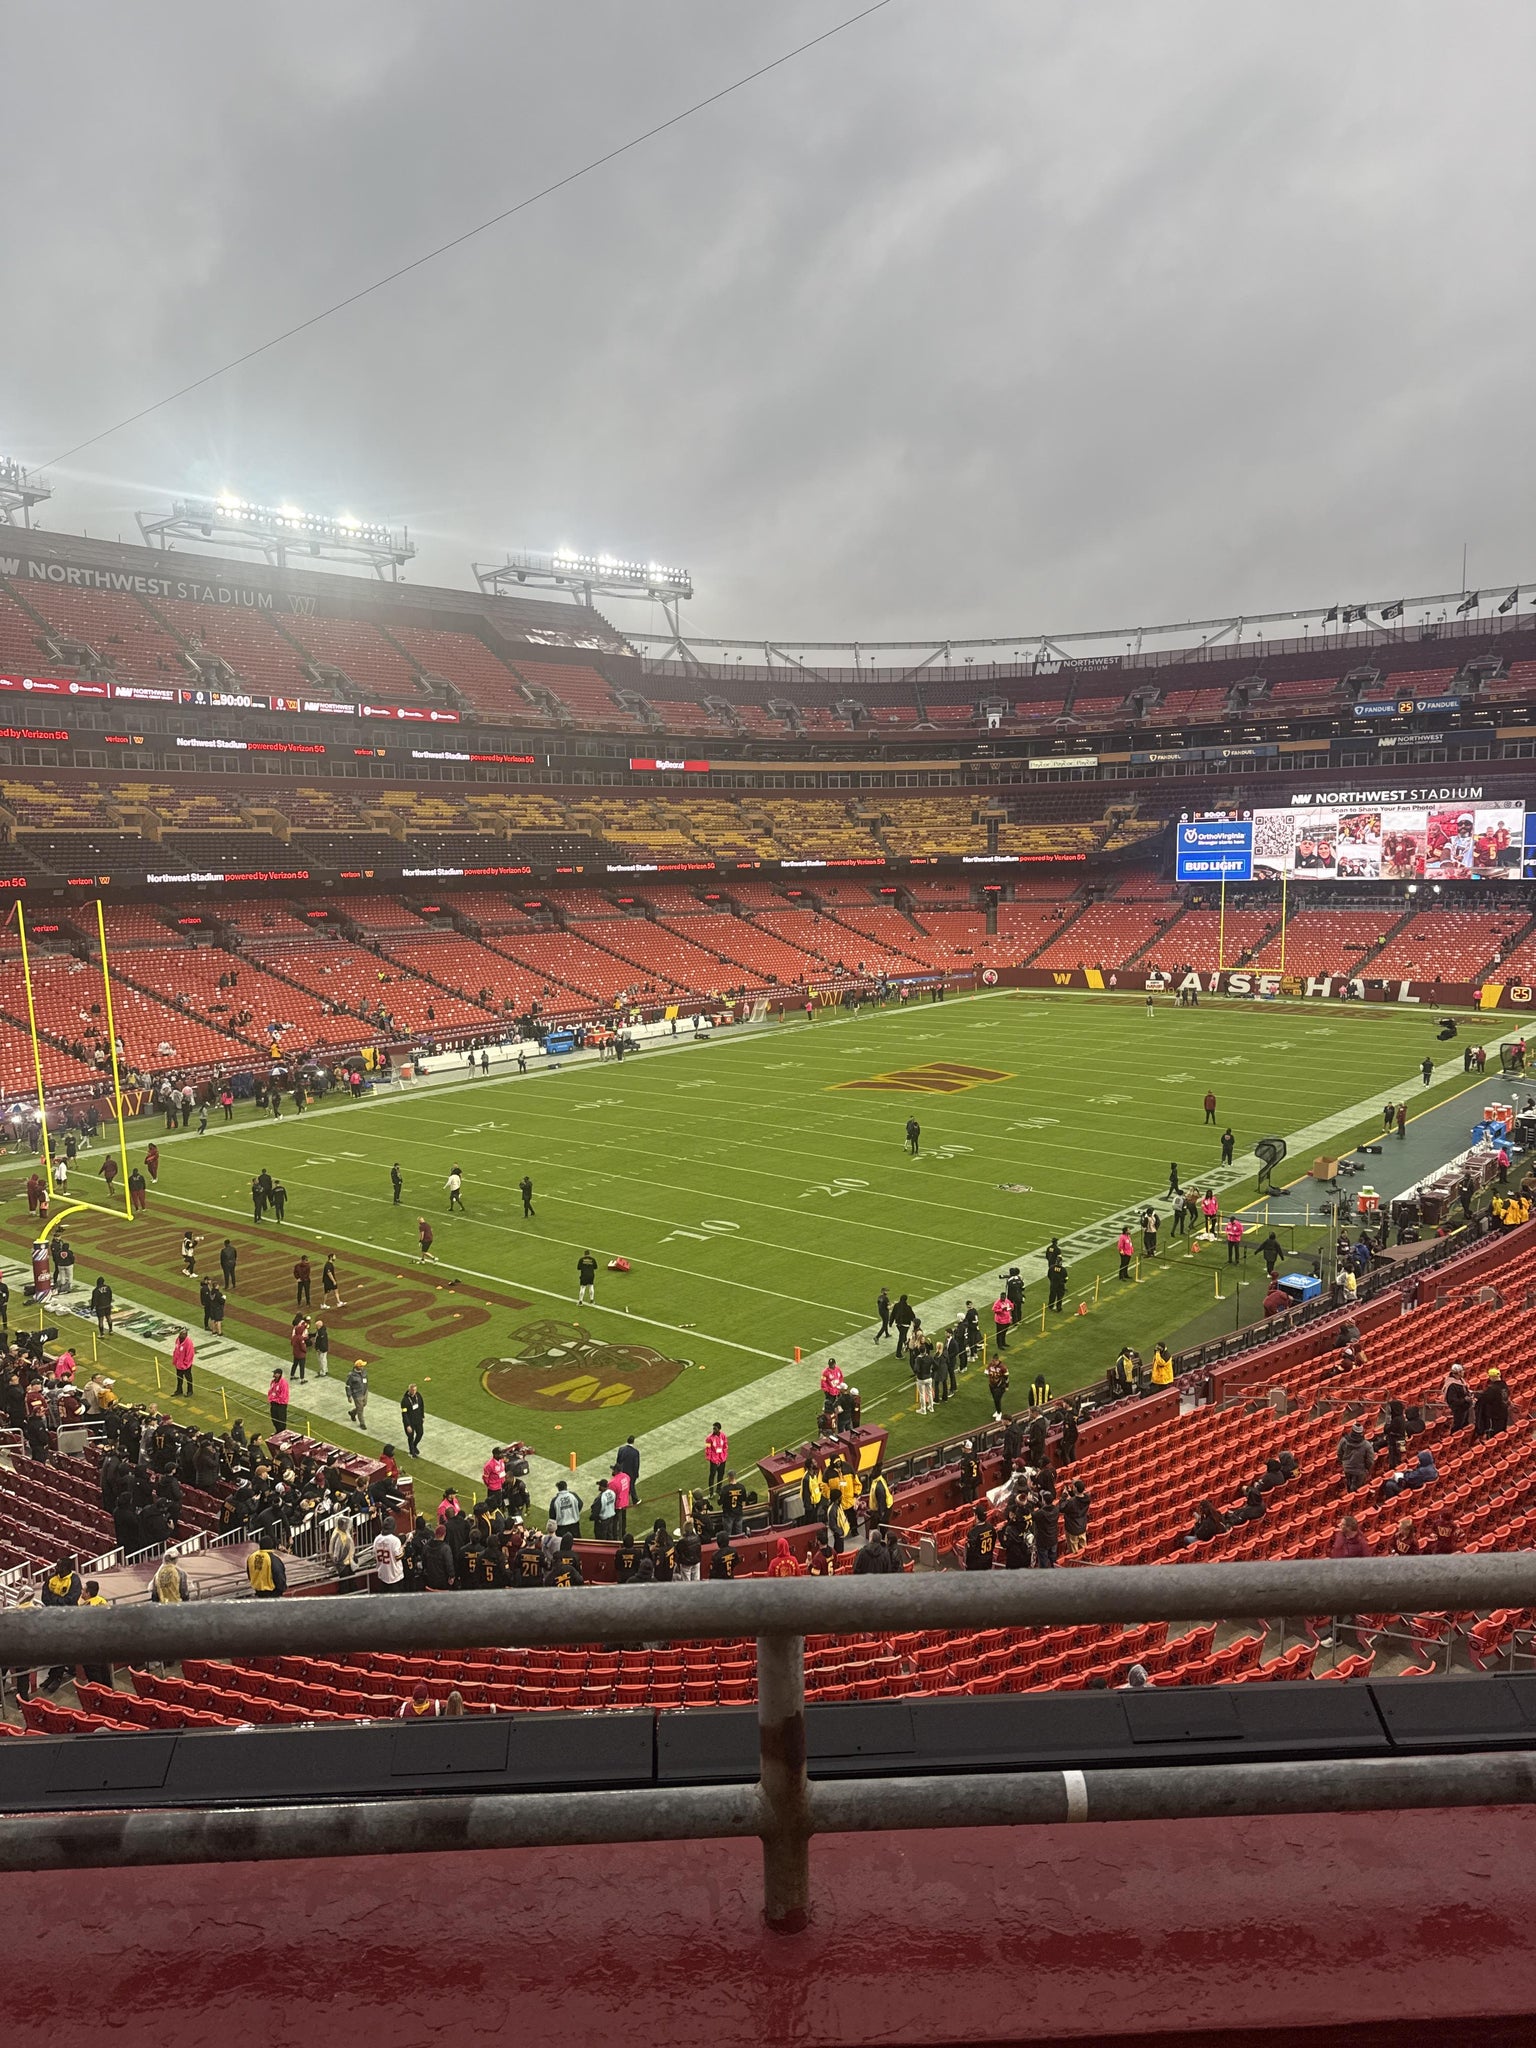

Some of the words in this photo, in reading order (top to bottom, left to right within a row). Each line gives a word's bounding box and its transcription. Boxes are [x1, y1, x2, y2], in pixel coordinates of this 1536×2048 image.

[28, 560, 172, 596] NORTHWEST
[177, 582, 273, 609] STADIUM
[1035, 661, 1062, 675] NW
[1063, 656, 1120, 668] NORTHWEST
[1074, 665, 1108, 673] STADIUM
[133, 687, 174, 697] NORTHWEST
[220, 694, 250, 708] 90:00
[1400, 702, 1412, 712] 25
[1427, 700, 1459, 709] FANDUEL
[1364, 705, 1395, 713] FANDUEL
[22, 729, 55, 740] Verizon
[55, 731, 69, 740] 5G
[105, 736, 128, 744] verizon
[1378, 736, 1397, 747] NW
[1397, 734, 1444, 743] NORTHWEST
[176, 738, 217, 748] Northwest
[217, 739, 247, 749] Stadium
[248, 743, 279, 751] powered
[288, 744, 314, 752] Verizon
[314, 745, 325, 753] 5G
[412, 750, 444, 759] Northwest
[470, 754, 495, 763] powered
[1157, 753, 1181, 761] FANDUEL
[1231, 749, 1256, 757] FANDUEL
[1291, 793, 1312, 805] NW
[1316, 790, 1407, 804] NORTHWEST
[1410, 787, 1482, 800] STADIUM
[1198, 832, 1245, 841] OrthoVirginia
[403, 868, 437, 876] Northwest
[437, 868, 463, 876] Stadium
[464, 868, 490, 876] powered
[499, 867, 521, 875] Verizon
[1185, 861, 1209, 871] BUD
[1209, 861, 1244, 871] LIGHT
[12, 878, 27, 887] 5G
[147, 873, 190, 883] Northwest
[190, 873, 224, 882] Stadium
[225, 872, 258, 882] powered
[259, 872, 268, 881] by
[268, 871, 297, 880] Verizon
[297, 871, 309, 879] 5G
[32, 924, 58, 933] verizon
[1513, 988, 1530, 1000] 25
[806, 1178, 870, 1197] 20
[669, 1219, 741, 1242] 10
[980, 1537, 993, 1554] 93
[376, 1549, 391, 1565] 22
[406, 1557, 413, 1570] 5
[522, 1562, 538, 1577] 20
[623, 1560, 633, 1568] 17
[486, 1566, 494, 1582] 5
